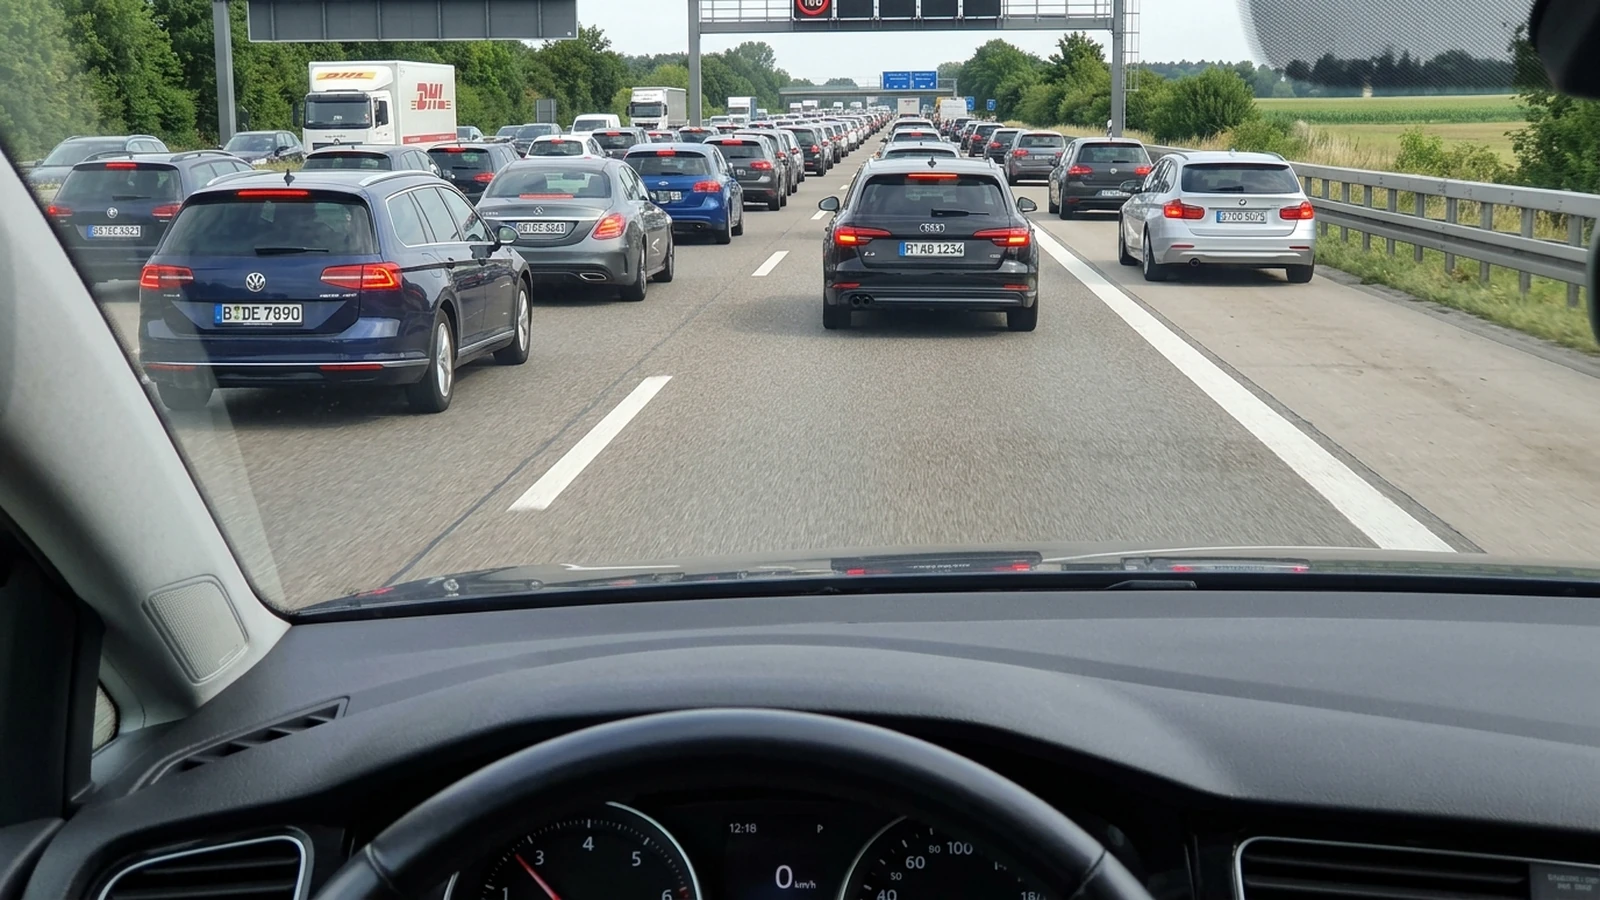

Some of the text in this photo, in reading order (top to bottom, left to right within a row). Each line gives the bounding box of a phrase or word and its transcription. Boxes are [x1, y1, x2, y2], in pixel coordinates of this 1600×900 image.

[416, 82, 446, 110] DHL
[937, 244, 963, 254] 1234
[223, 306, 300, 321] B DE 7890
[729, 823, 757, 833] 12:18
[817, 824, 824, 834] P
[582, 836, 594, 851] 4
[947, 841, 974, 855] 100
[535, 850, 545, 866] 3
[631, 851, 642, 867] 5
[905, 856, 926, 870] 60
[775, 864, 793, 889] 0
[502, 887, 509, 900] 1
[662, 889, 673, 900] 6
[877, 889, 898, 900] 40
